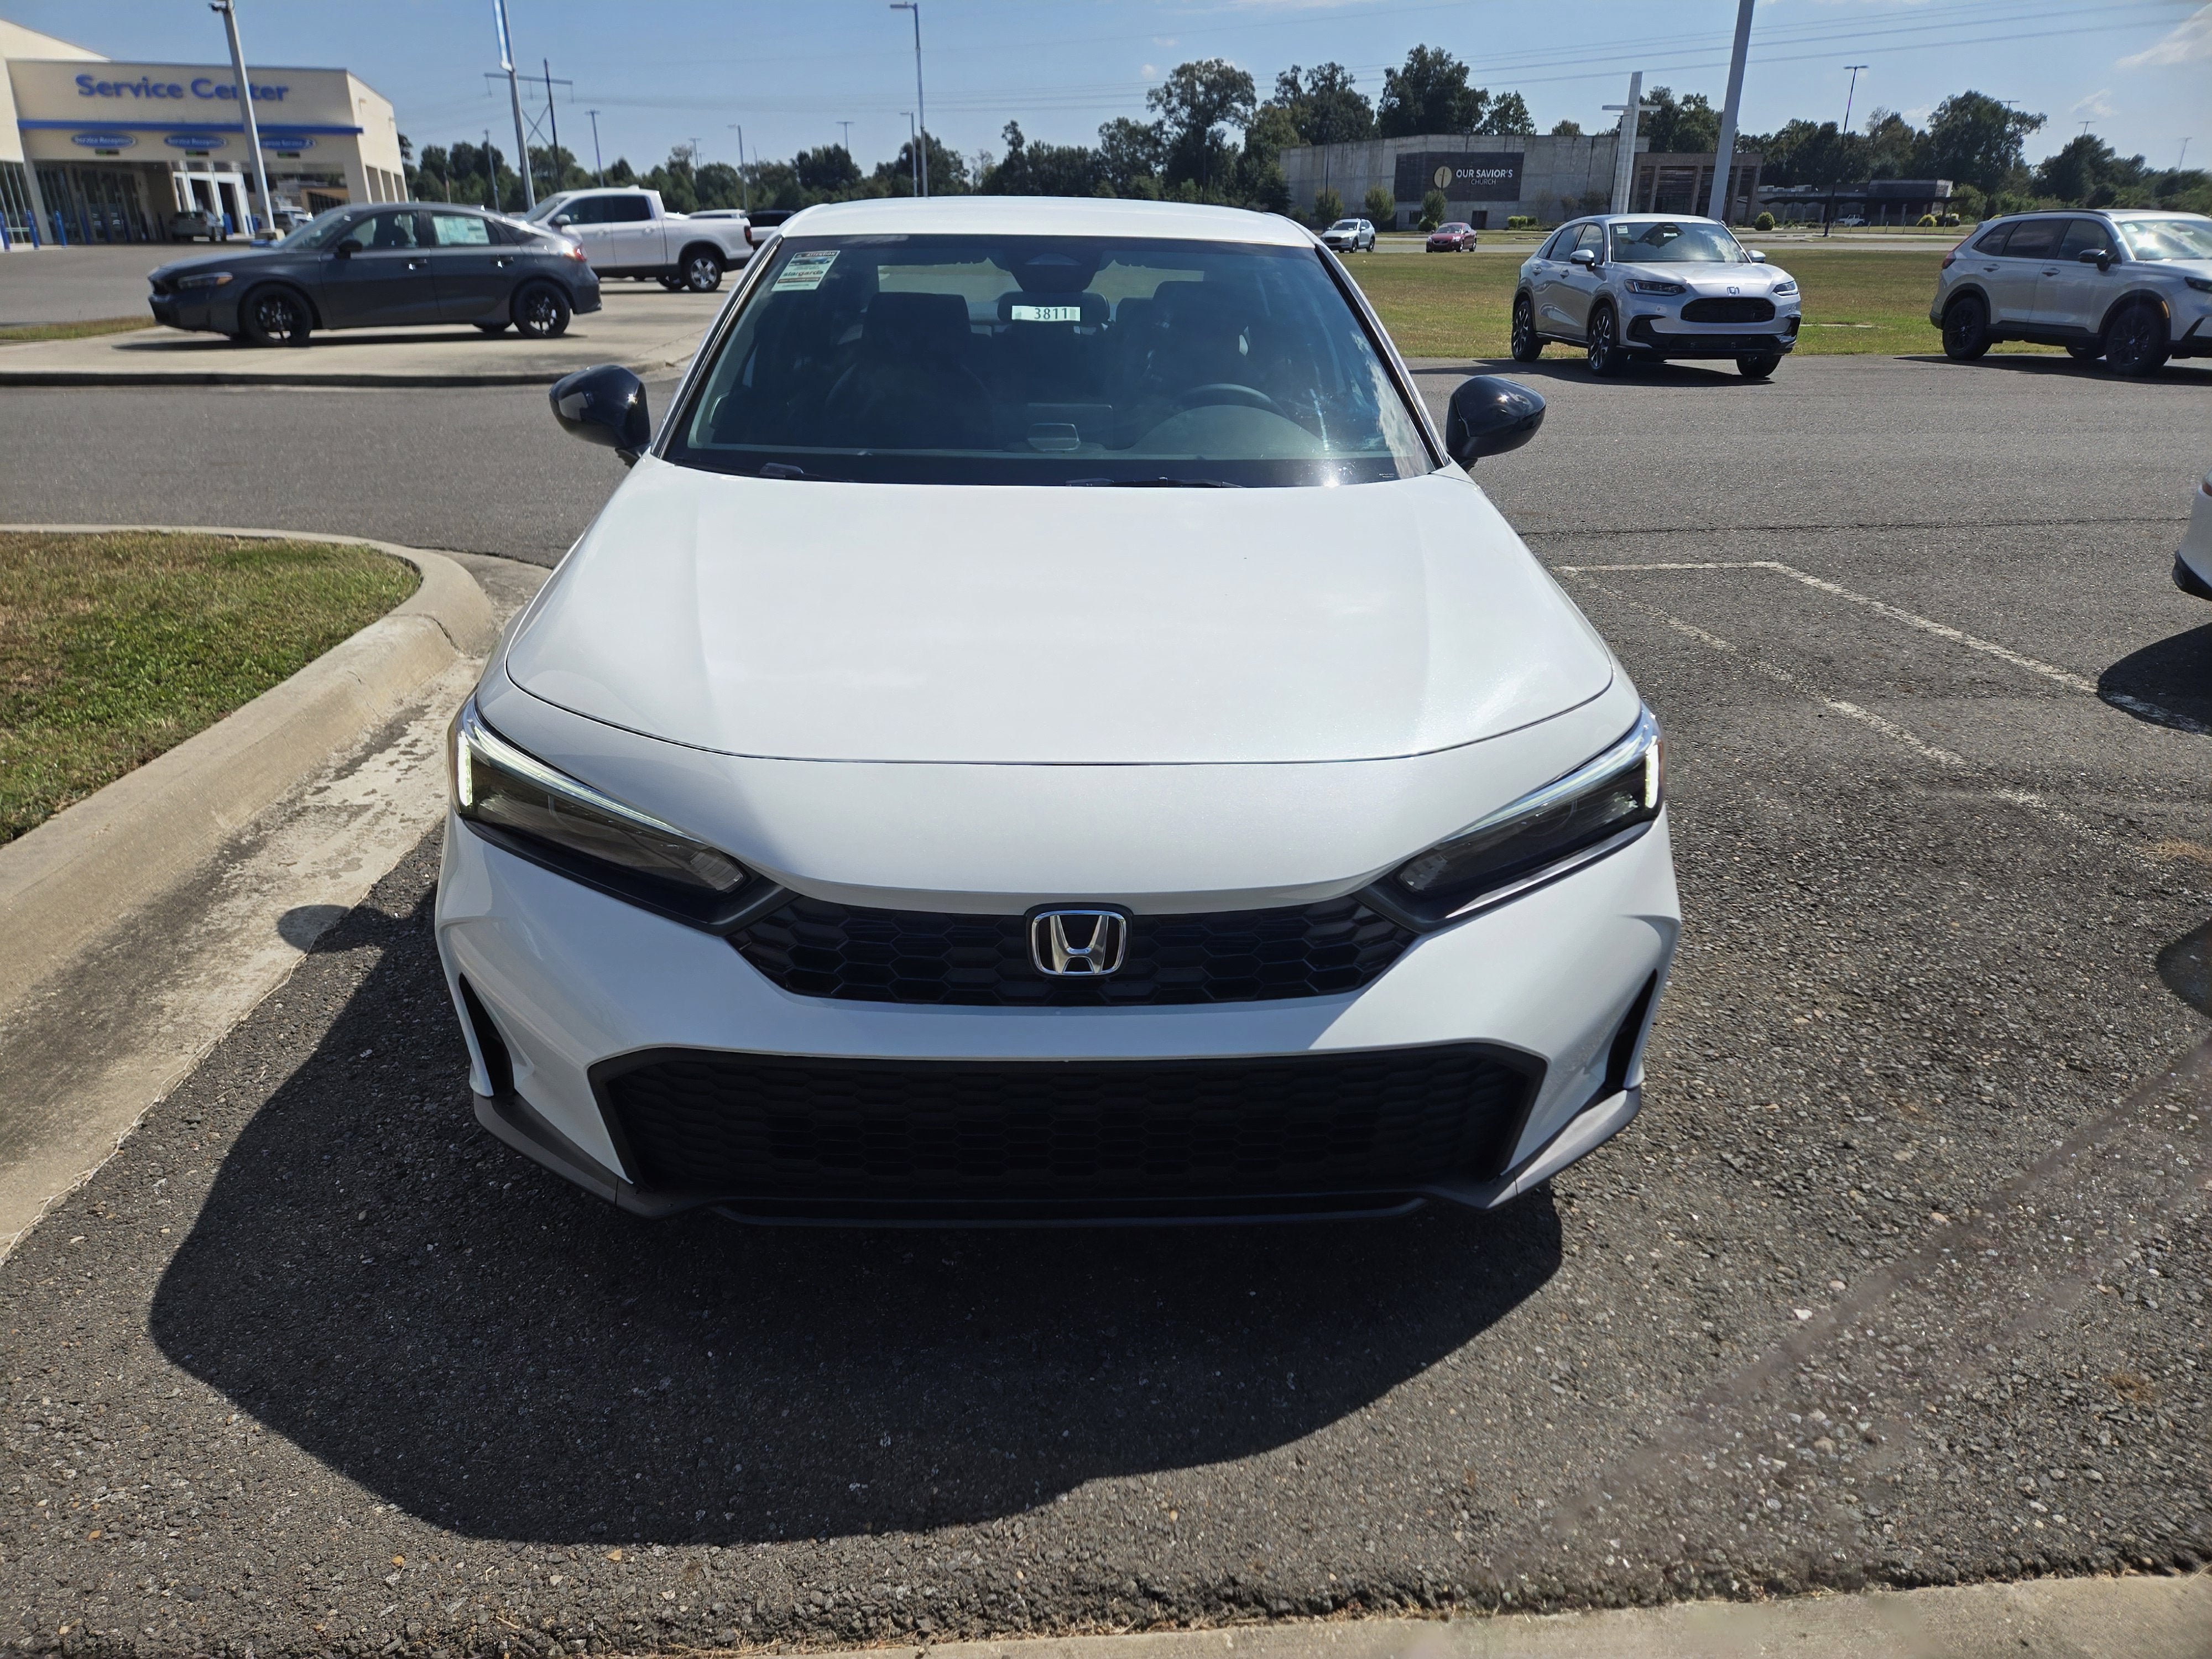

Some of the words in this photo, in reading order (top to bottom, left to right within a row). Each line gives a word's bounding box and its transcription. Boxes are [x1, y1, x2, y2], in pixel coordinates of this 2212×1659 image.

[76, 74, 183, 98] Service
[1456, 169, 1474, 178] OUR
[1477, 169, 1513, 178] SAVIOR'S
[1034, 307, 1067, 319] 3811
